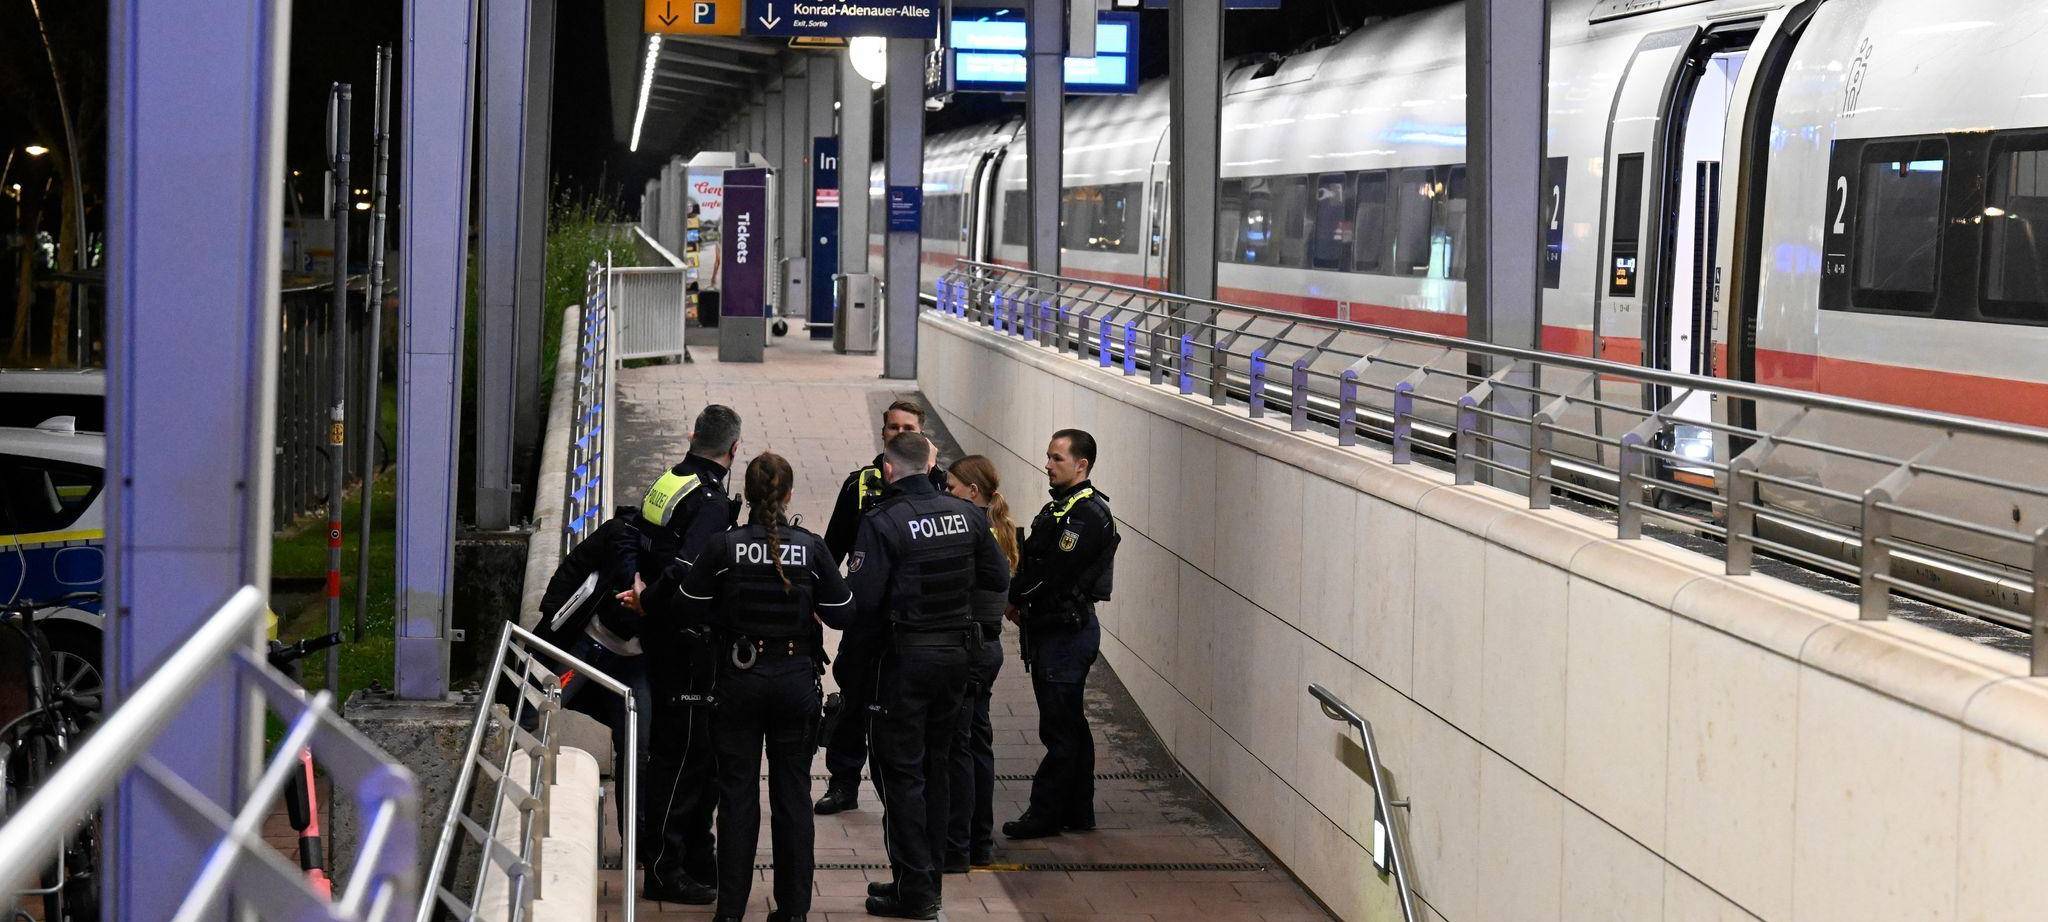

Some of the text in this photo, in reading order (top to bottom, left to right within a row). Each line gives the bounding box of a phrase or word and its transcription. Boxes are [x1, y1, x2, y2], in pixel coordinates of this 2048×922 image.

[695, 5, 709, 23] P
[793, 3, 930, 17] Konrad-Adenauer-Allee
[808, 20, 828, 28] Sortie
[820, 152, 839, 170] In
[1550, 184, 1560, 230] 2
[1833, 175, 1848, 234] 2
[737, 212, 750, 264] Tickets
[649, 488, 669, 510] POLIZEI
[908, 514, 969, 540] POLIZEI
[736, 542, 807, 566] POLZEI
